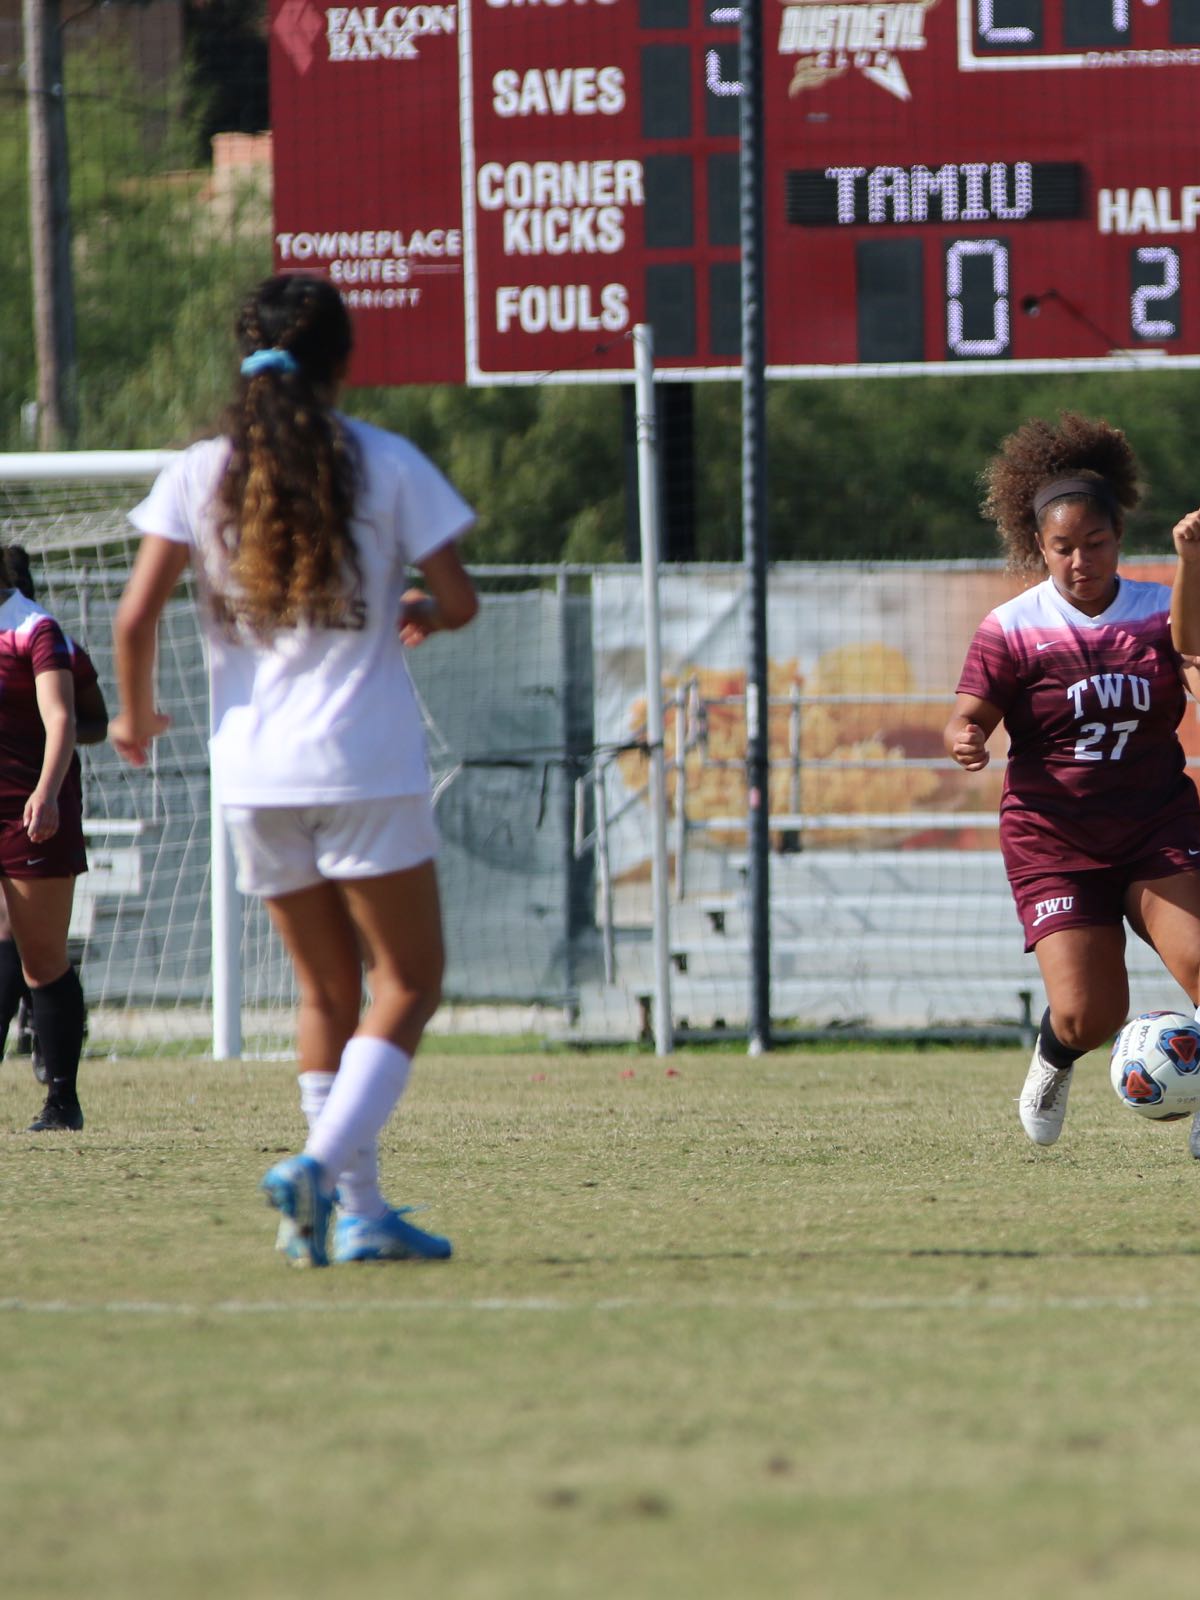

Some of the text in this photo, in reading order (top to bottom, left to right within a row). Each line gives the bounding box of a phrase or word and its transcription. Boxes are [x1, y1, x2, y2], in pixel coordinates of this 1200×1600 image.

[325, 5, 456, 35] FALCON
[327, 33, 419, 62] BANK
[492, 66, 626, 117] SAVES
[477, 160, 645, 210] CORNER
[825, 162, 1033, 224] TAMIU
[276, 229, 462, 260] TOWNEPLACE
[502, 207, 626, 255] KICKS
[329, 258, 409, 283] SUITES
[1130, 247, 1180, 337] 2
[496, 283, 629, 333] FOULS
[946, 239, 1008, 356] 0
[1066, 673, 1151, 720] TWU
[1074, 720, 1139, 761] 27
[1035, 896, 1075, 917] TWU
[1138, 1025, 1151, 1053] NCAA
